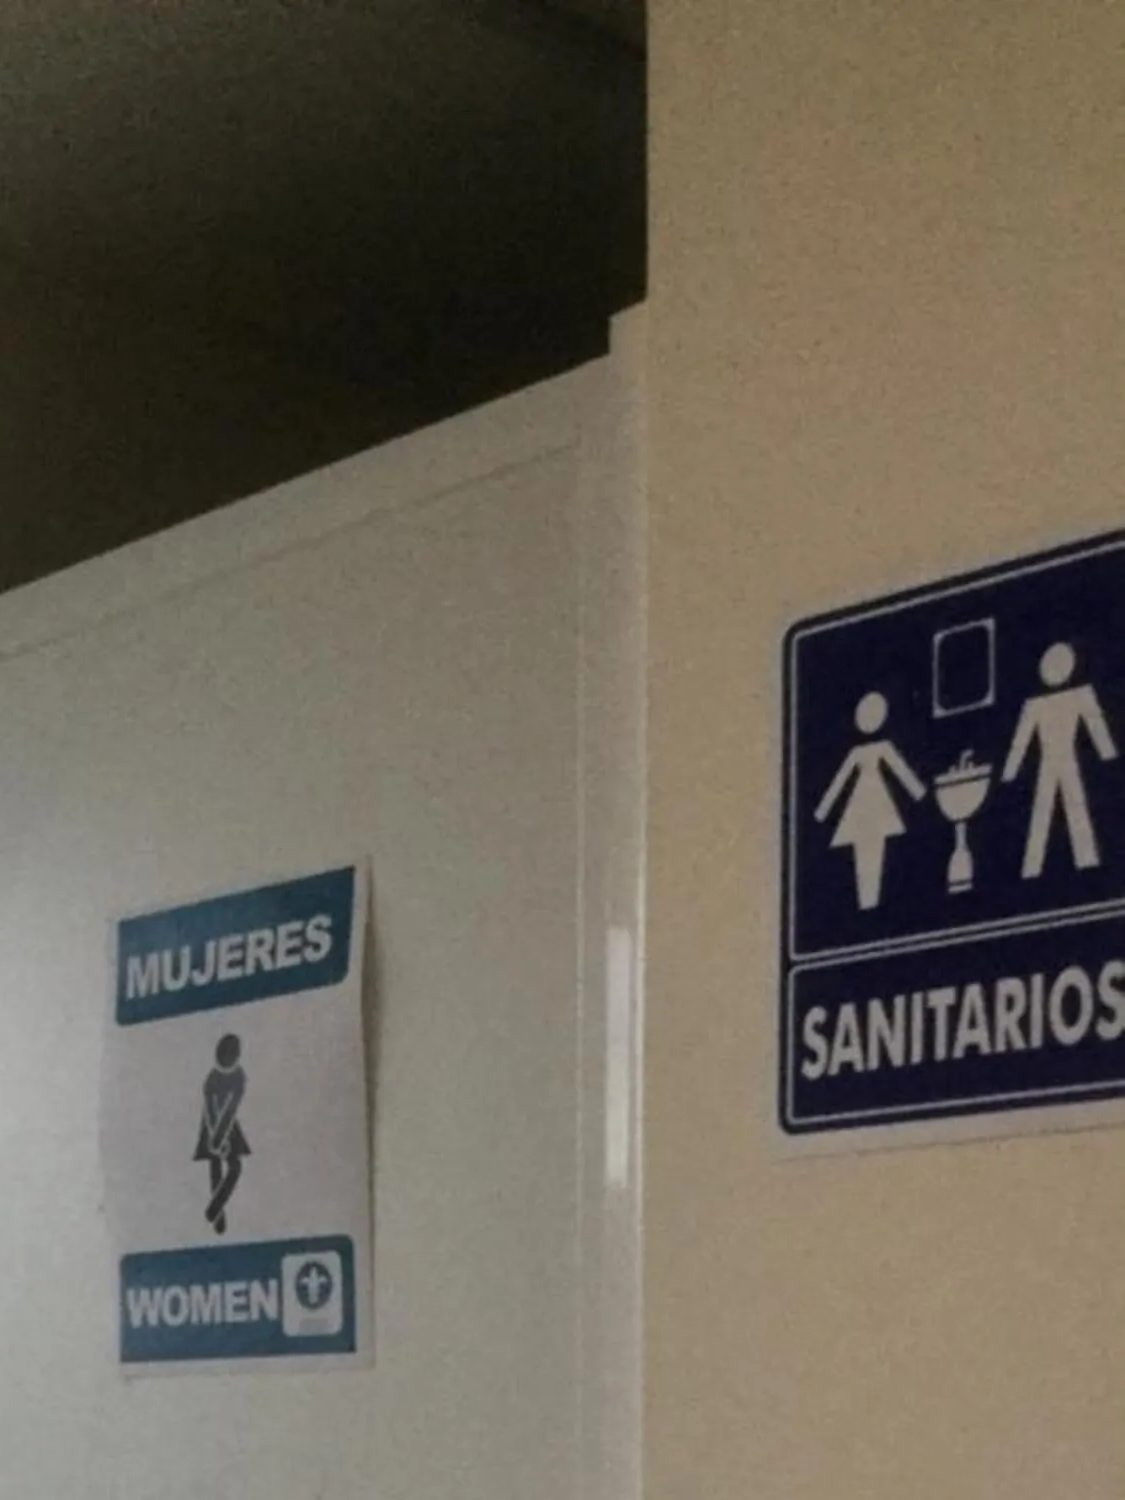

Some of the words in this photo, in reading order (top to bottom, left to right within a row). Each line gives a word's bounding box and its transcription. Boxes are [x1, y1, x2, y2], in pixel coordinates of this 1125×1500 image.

[126, 914, 332, 999] MUJERES
[801, 960, 1125, 1080] SANITARIOS
[126, 1279, 280, 1330] WOMEN
